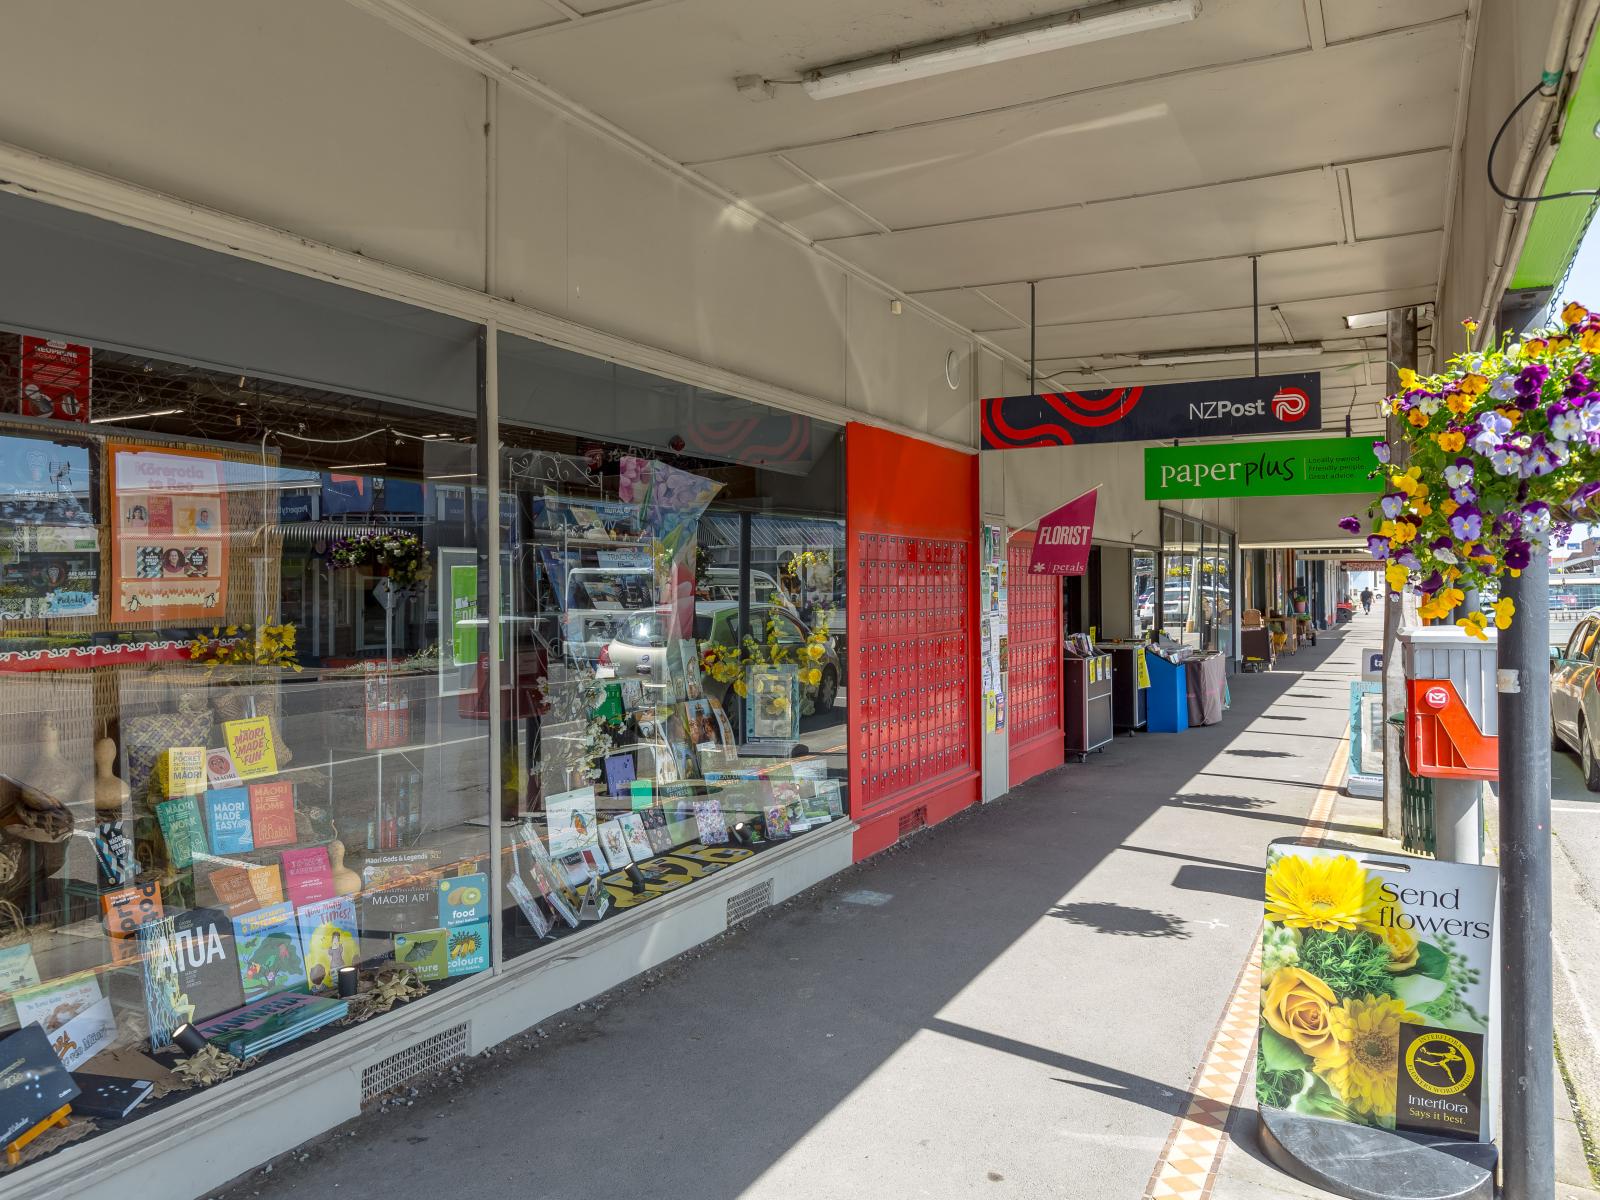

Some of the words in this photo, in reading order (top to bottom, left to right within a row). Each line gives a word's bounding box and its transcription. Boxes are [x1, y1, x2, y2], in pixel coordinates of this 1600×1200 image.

[1190, 400, 1265, 420] NZPost
[1308, 456, 1333, 464] Locally
[1160, 462, 1241, 488] paper
[1244, 452, 1295, 487] plus
[1038, 525, 1091, 546] FLORIST
[1052, 561, 1085, 573] petals
[239, 738, 264, 754] MADE
[244, 752, 261, 766] FUN
[256, 801, 285, 811] HOME
[170, 817, 197, 830] WORK
[215, 812, 241, 821] MADE
[382, 855, 398, 863] Gods
[403, 852, 428, 862] Legends
[411, 893, 429, 902] ART
[1378, 882, 1460, 910] Send
[452, 907, 475, 919] food
[1379, 906, 1490, 940] flowers
[157, 922, 226, 978] ATUA
[448, 955, 484, 968] colours
[1418, 1033, 1463, 1048] INTERFLORA
[1408, 1064, 1432, 1091] FLOWERS
[1433, 1073, 1473, 1094] WORLDWIDE
[1408, 1094, 1468, 1114] Interflora
[1409, 1107, 1431, 1120] Says
[1433, 1112, 1440, 1120] it
[1443, 1112, 1466, 1125] best.
